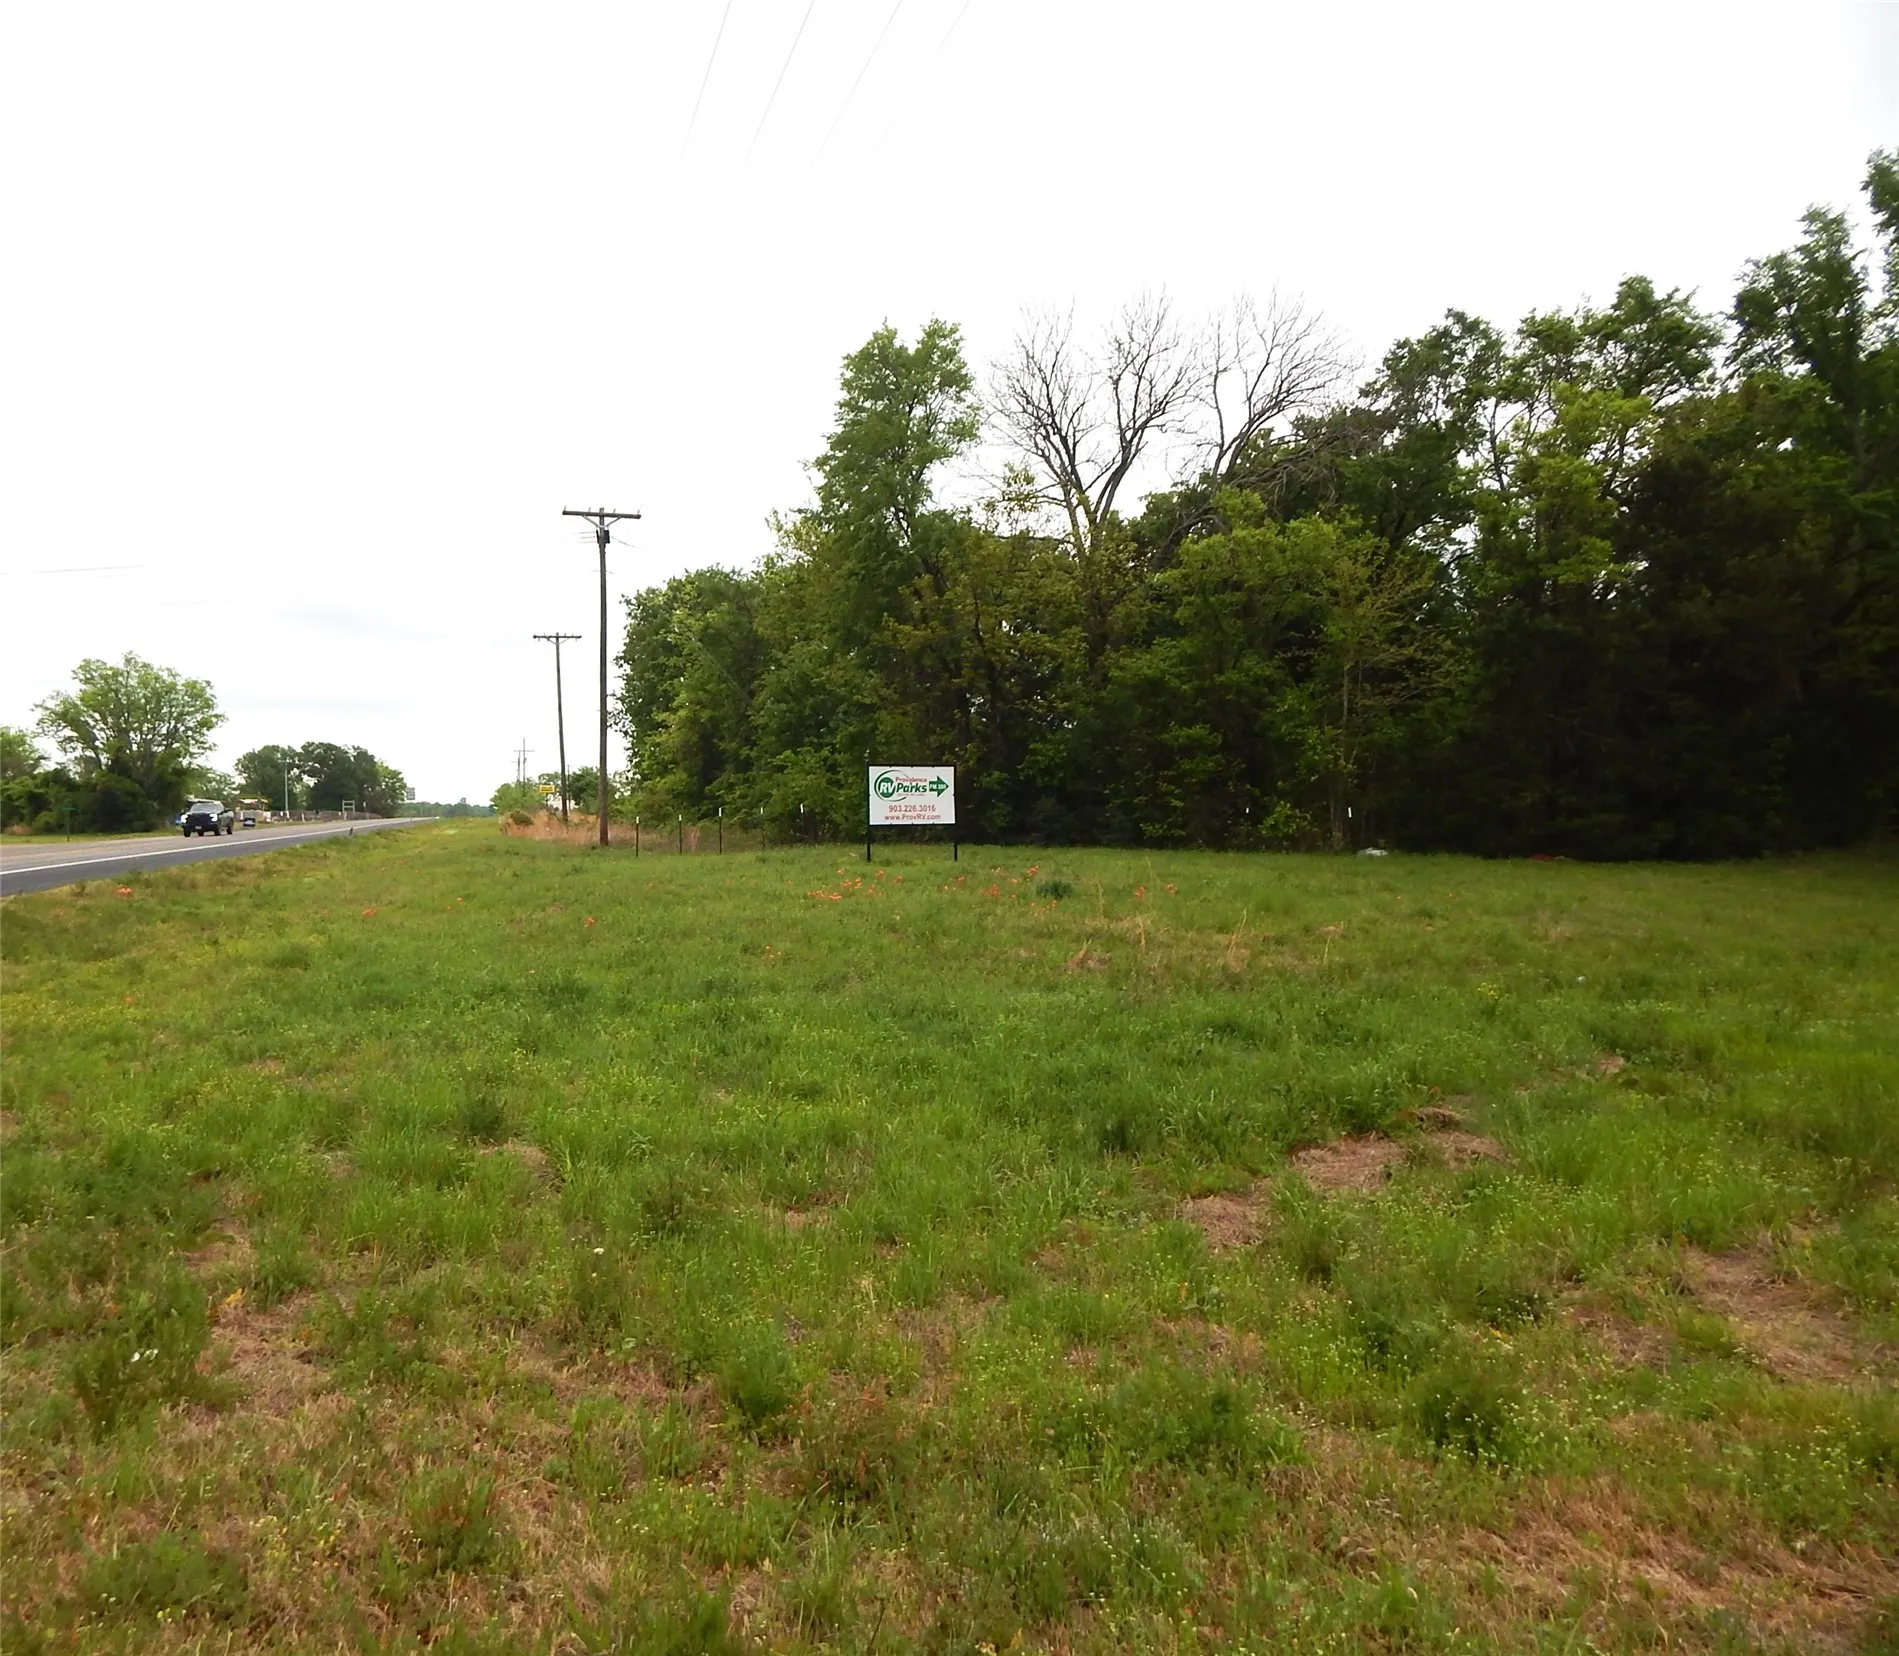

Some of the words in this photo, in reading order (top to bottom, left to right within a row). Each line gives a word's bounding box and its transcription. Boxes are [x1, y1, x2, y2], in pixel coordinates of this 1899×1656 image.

[880, 782, 895, 793] RV
[896, 782, 927, 793] Parks
[888, 804, 936, 812] 903.226.3016
